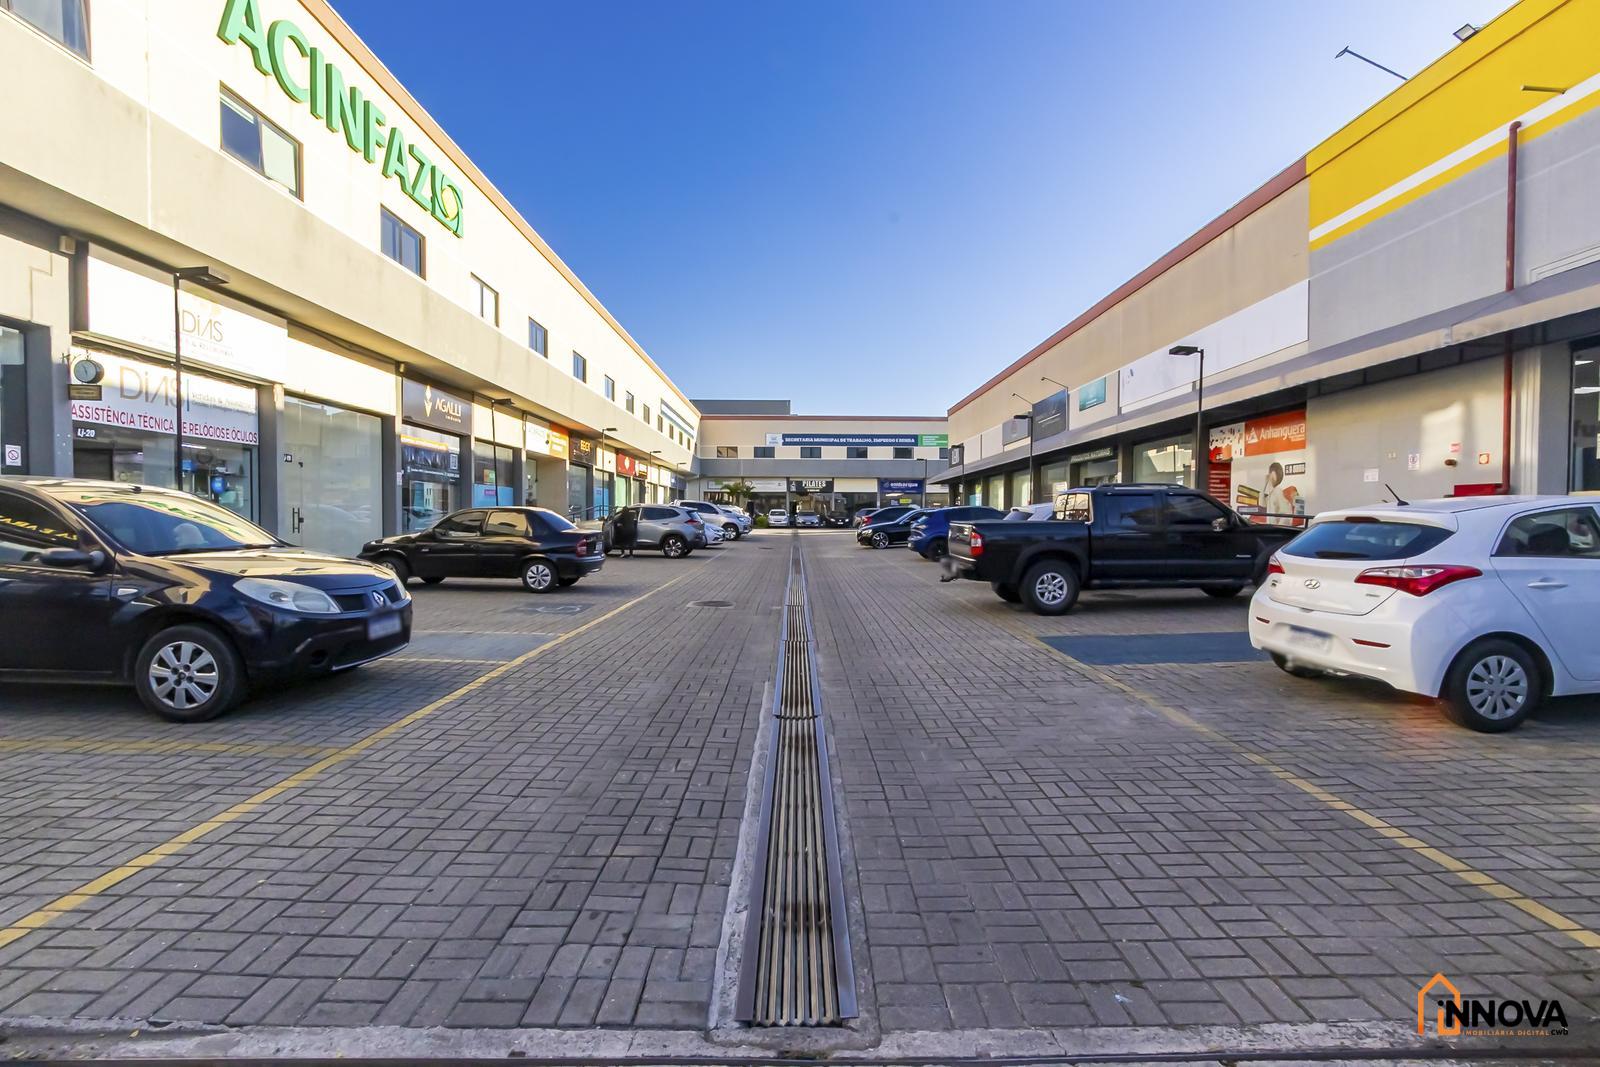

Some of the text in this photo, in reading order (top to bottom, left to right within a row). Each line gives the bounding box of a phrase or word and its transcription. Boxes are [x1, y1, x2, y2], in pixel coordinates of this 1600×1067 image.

[217, 0, 435, 213] ACINFAZ
[71, 404, 135, 427] ASSISTÊNCIA
[138, 412, 175, 432] TÉCNICA
[231, 426, 257, 443] ÓCULOS
[1260, 423, 1305, 440] Anhanguera
